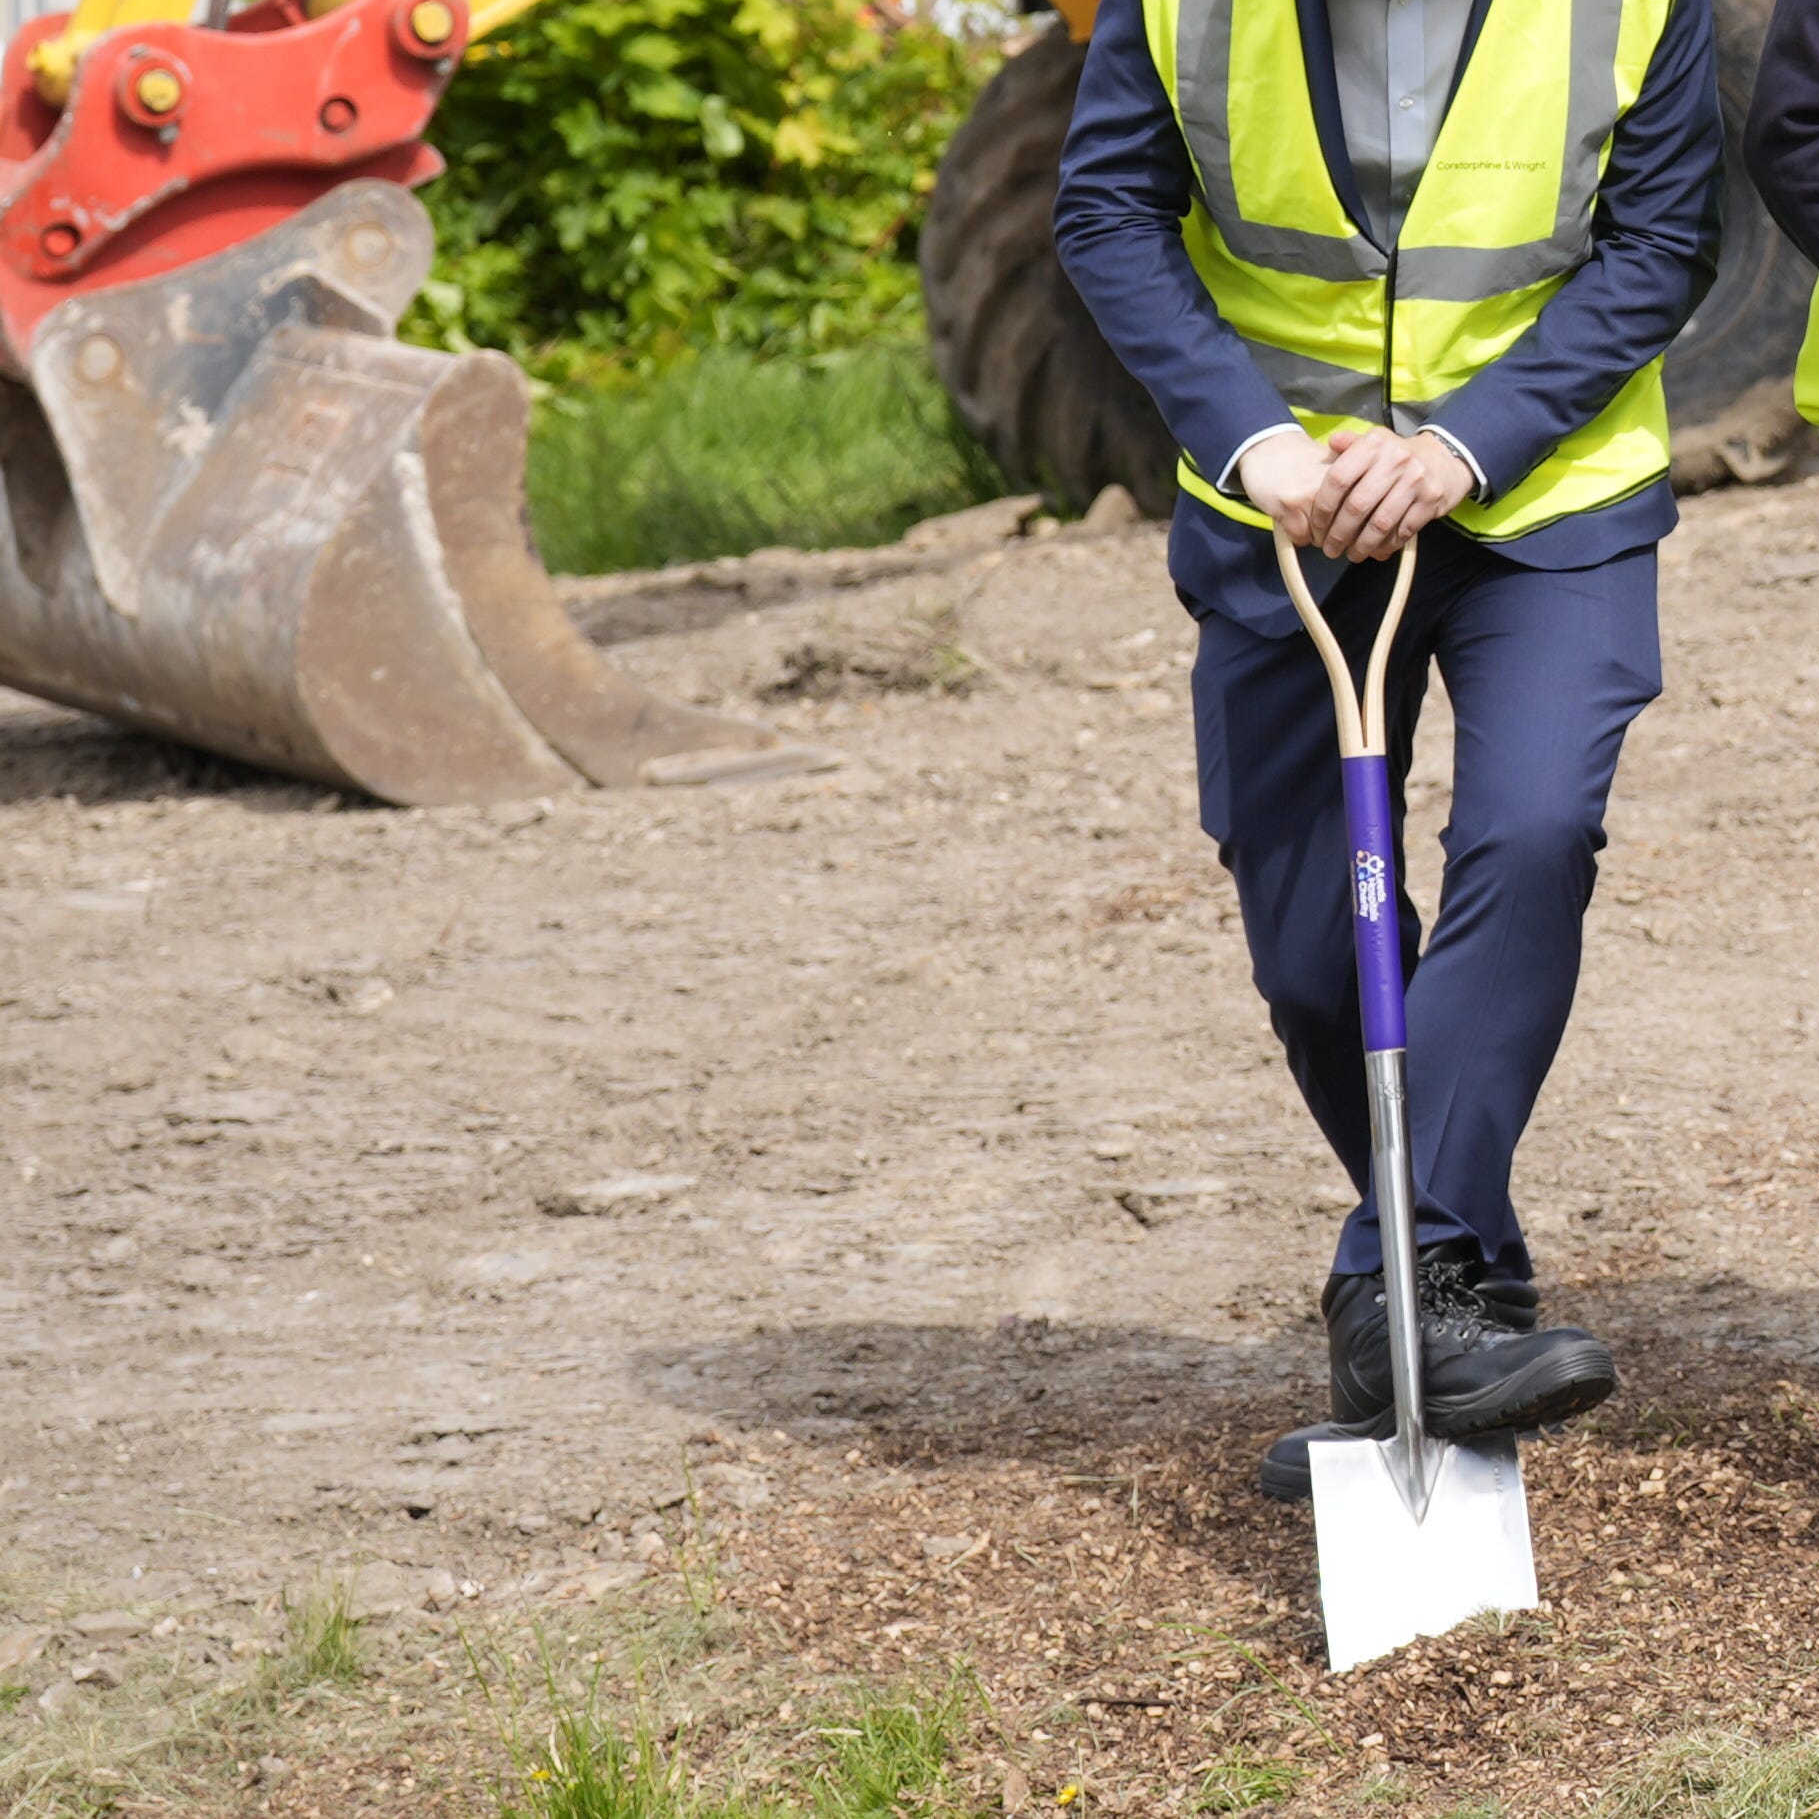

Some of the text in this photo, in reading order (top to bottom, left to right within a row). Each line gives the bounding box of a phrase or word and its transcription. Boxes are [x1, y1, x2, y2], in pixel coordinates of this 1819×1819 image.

[1436, 160, 1501, 171] Corstorphine
[1511, 160, 1546, 172] Wright
[1359, 881, 1369, 917] Charity
[1367, 877, 1379, 922] Hospitals
[1376, 873, 1387, 903] Leeds
